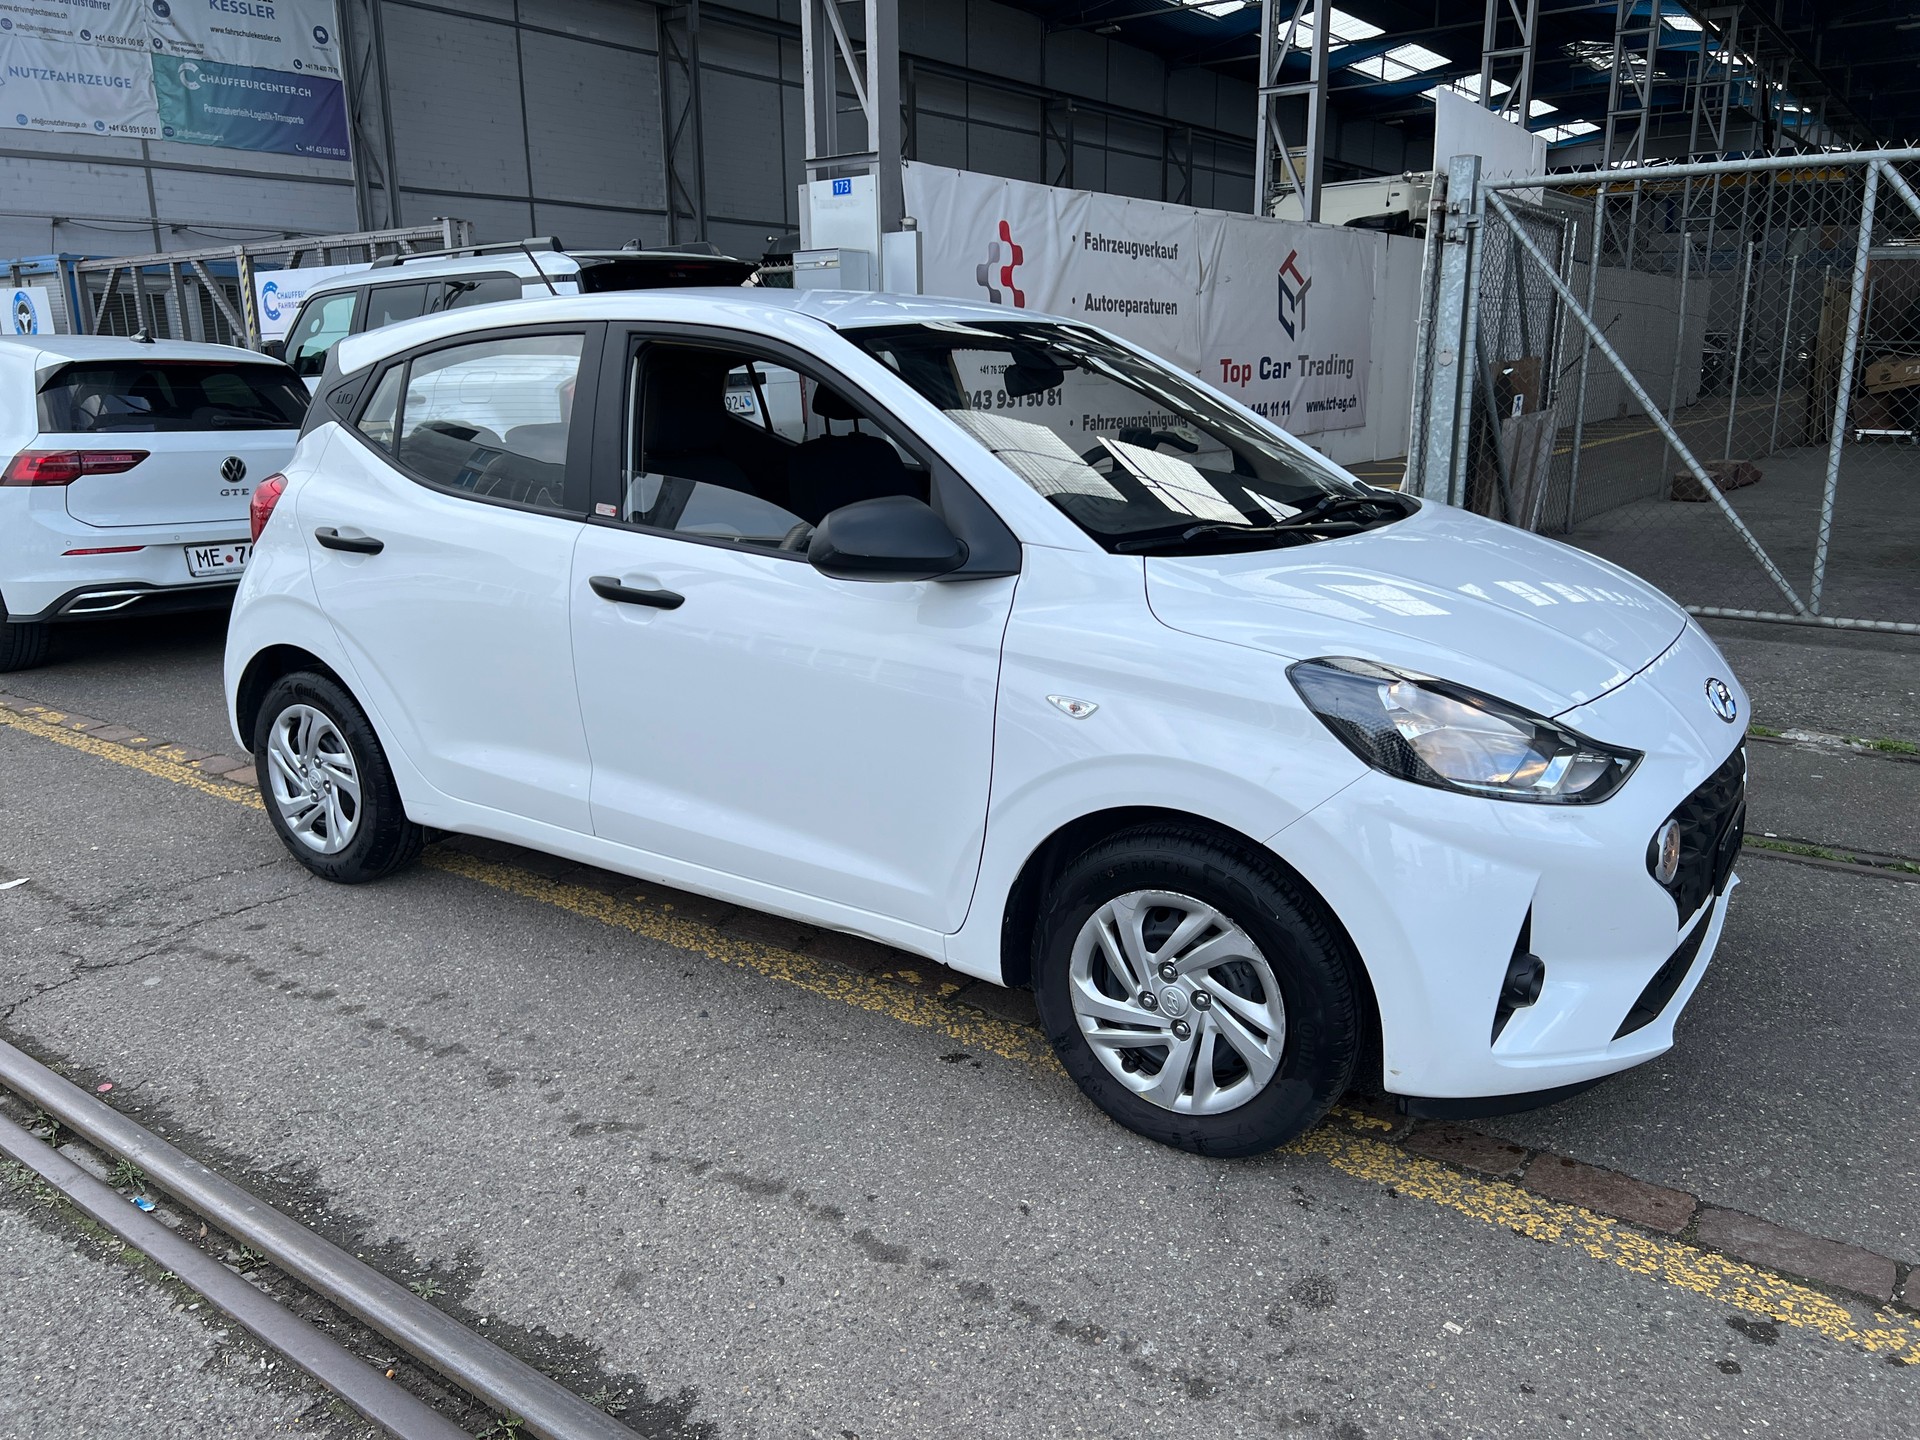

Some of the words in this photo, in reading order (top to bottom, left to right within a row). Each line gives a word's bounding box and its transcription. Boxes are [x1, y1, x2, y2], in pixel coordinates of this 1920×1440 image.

[210, 0, 275, 20] KESSLER
[8, 66, 132, 89] NUTZFAHRZEUGE
[200, 73, 312, 97] CHAUFFEURCENTER.CH
[834, 181, 850, 194] 173
[1084, 231, 1178, 260] Fahrzeugverkauf
[1084, 292, 1178, 317] Autoreparaturen
[1220, 359, 1251, 387] Top
[1259, 356, 1291, 380] Car
[1298, 354, 1354, 379] Trading
[725, 396, 745, 411] 924
[1047, 388, 1062, 406] 81
[1306, 394, 1357, 413] www.tct-ag.ch
[220, 488, 249, 497] GTE
[195, 548, 224, 568] ME
